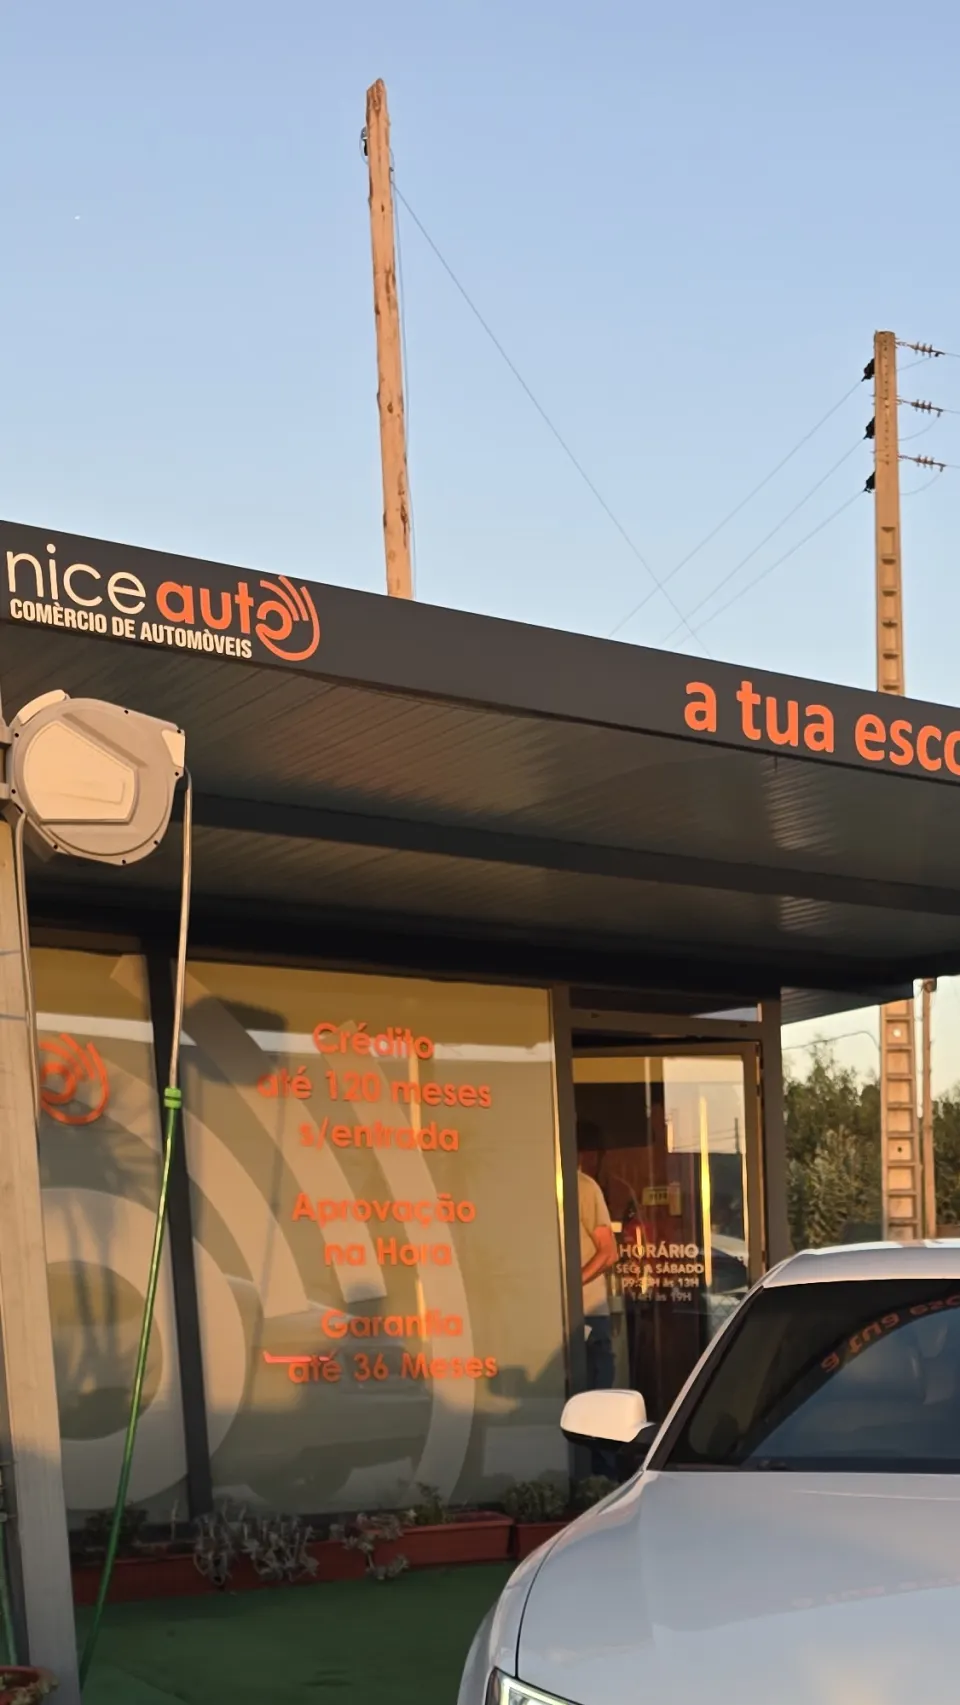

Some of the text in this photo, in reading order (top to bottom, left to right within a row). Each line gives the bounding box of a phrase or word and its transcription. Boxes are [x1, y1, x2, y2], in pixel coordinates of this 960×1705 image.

[112, 619, 136, 640] DE
[684, 681, 717, 733] a
[736, 680, 834, 753] tua
[312, 1022, 435, 1059] Crédito
[257, 1065, 493, 1108] até 120 meses
[299, 1116, 460, 1152] s/entrada
[291, 1191, 477, 1229] Aprovação
[324, 1237, 453, 1266] na Hora
[620, 1242, 699, 1259] HORÁRIO
[643, 1263, 654, 1275] A
[656, 1262, 705, 1275] SÁBADO
[678, 1277, 699, 1288] 13H
[320, 1308, 464, 1338] Garantia
[287, 1349, 499, 1384] até 36 Meses
